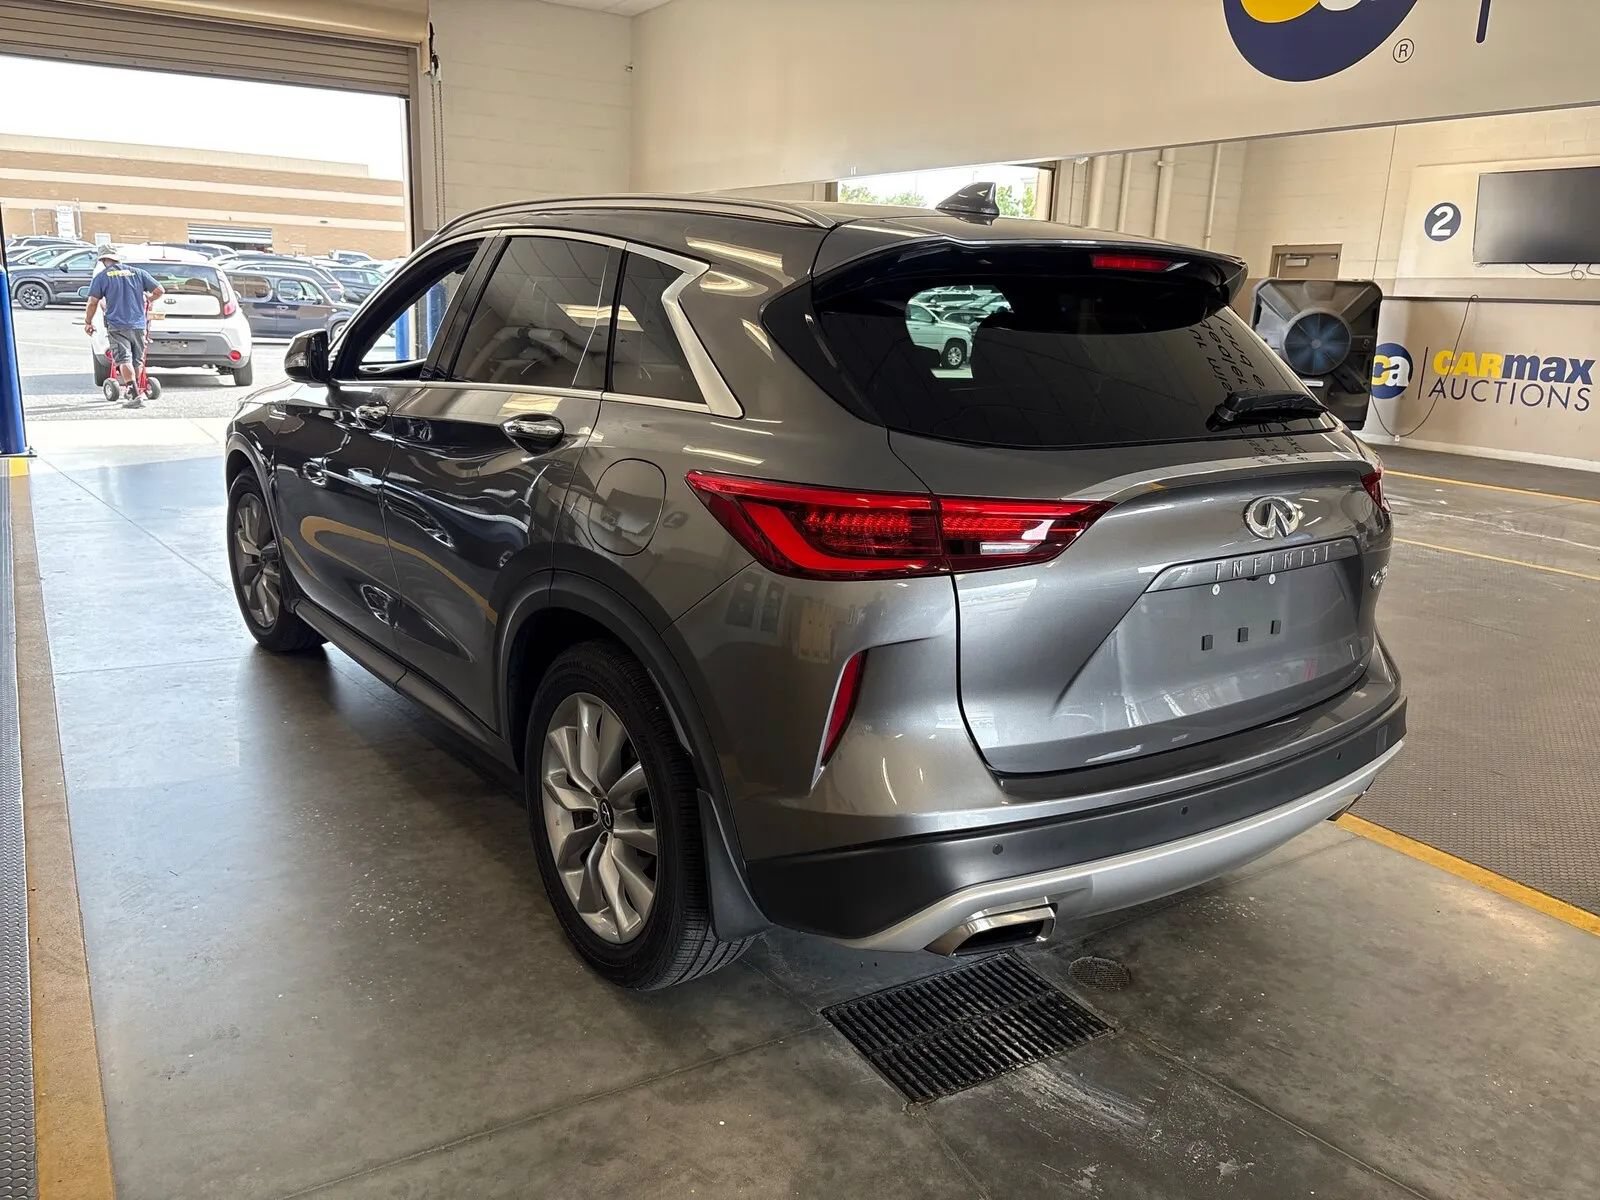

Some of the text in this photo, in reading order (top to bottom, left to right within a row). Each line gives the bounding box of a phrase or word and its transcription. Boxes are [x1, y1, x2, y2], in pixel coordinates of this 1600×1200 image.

[1431, 205, 1454, 237] 2
[1428, 378, 1591, 412] AUCTIONS
[1214, 545, 1330, 582] INFINITI
